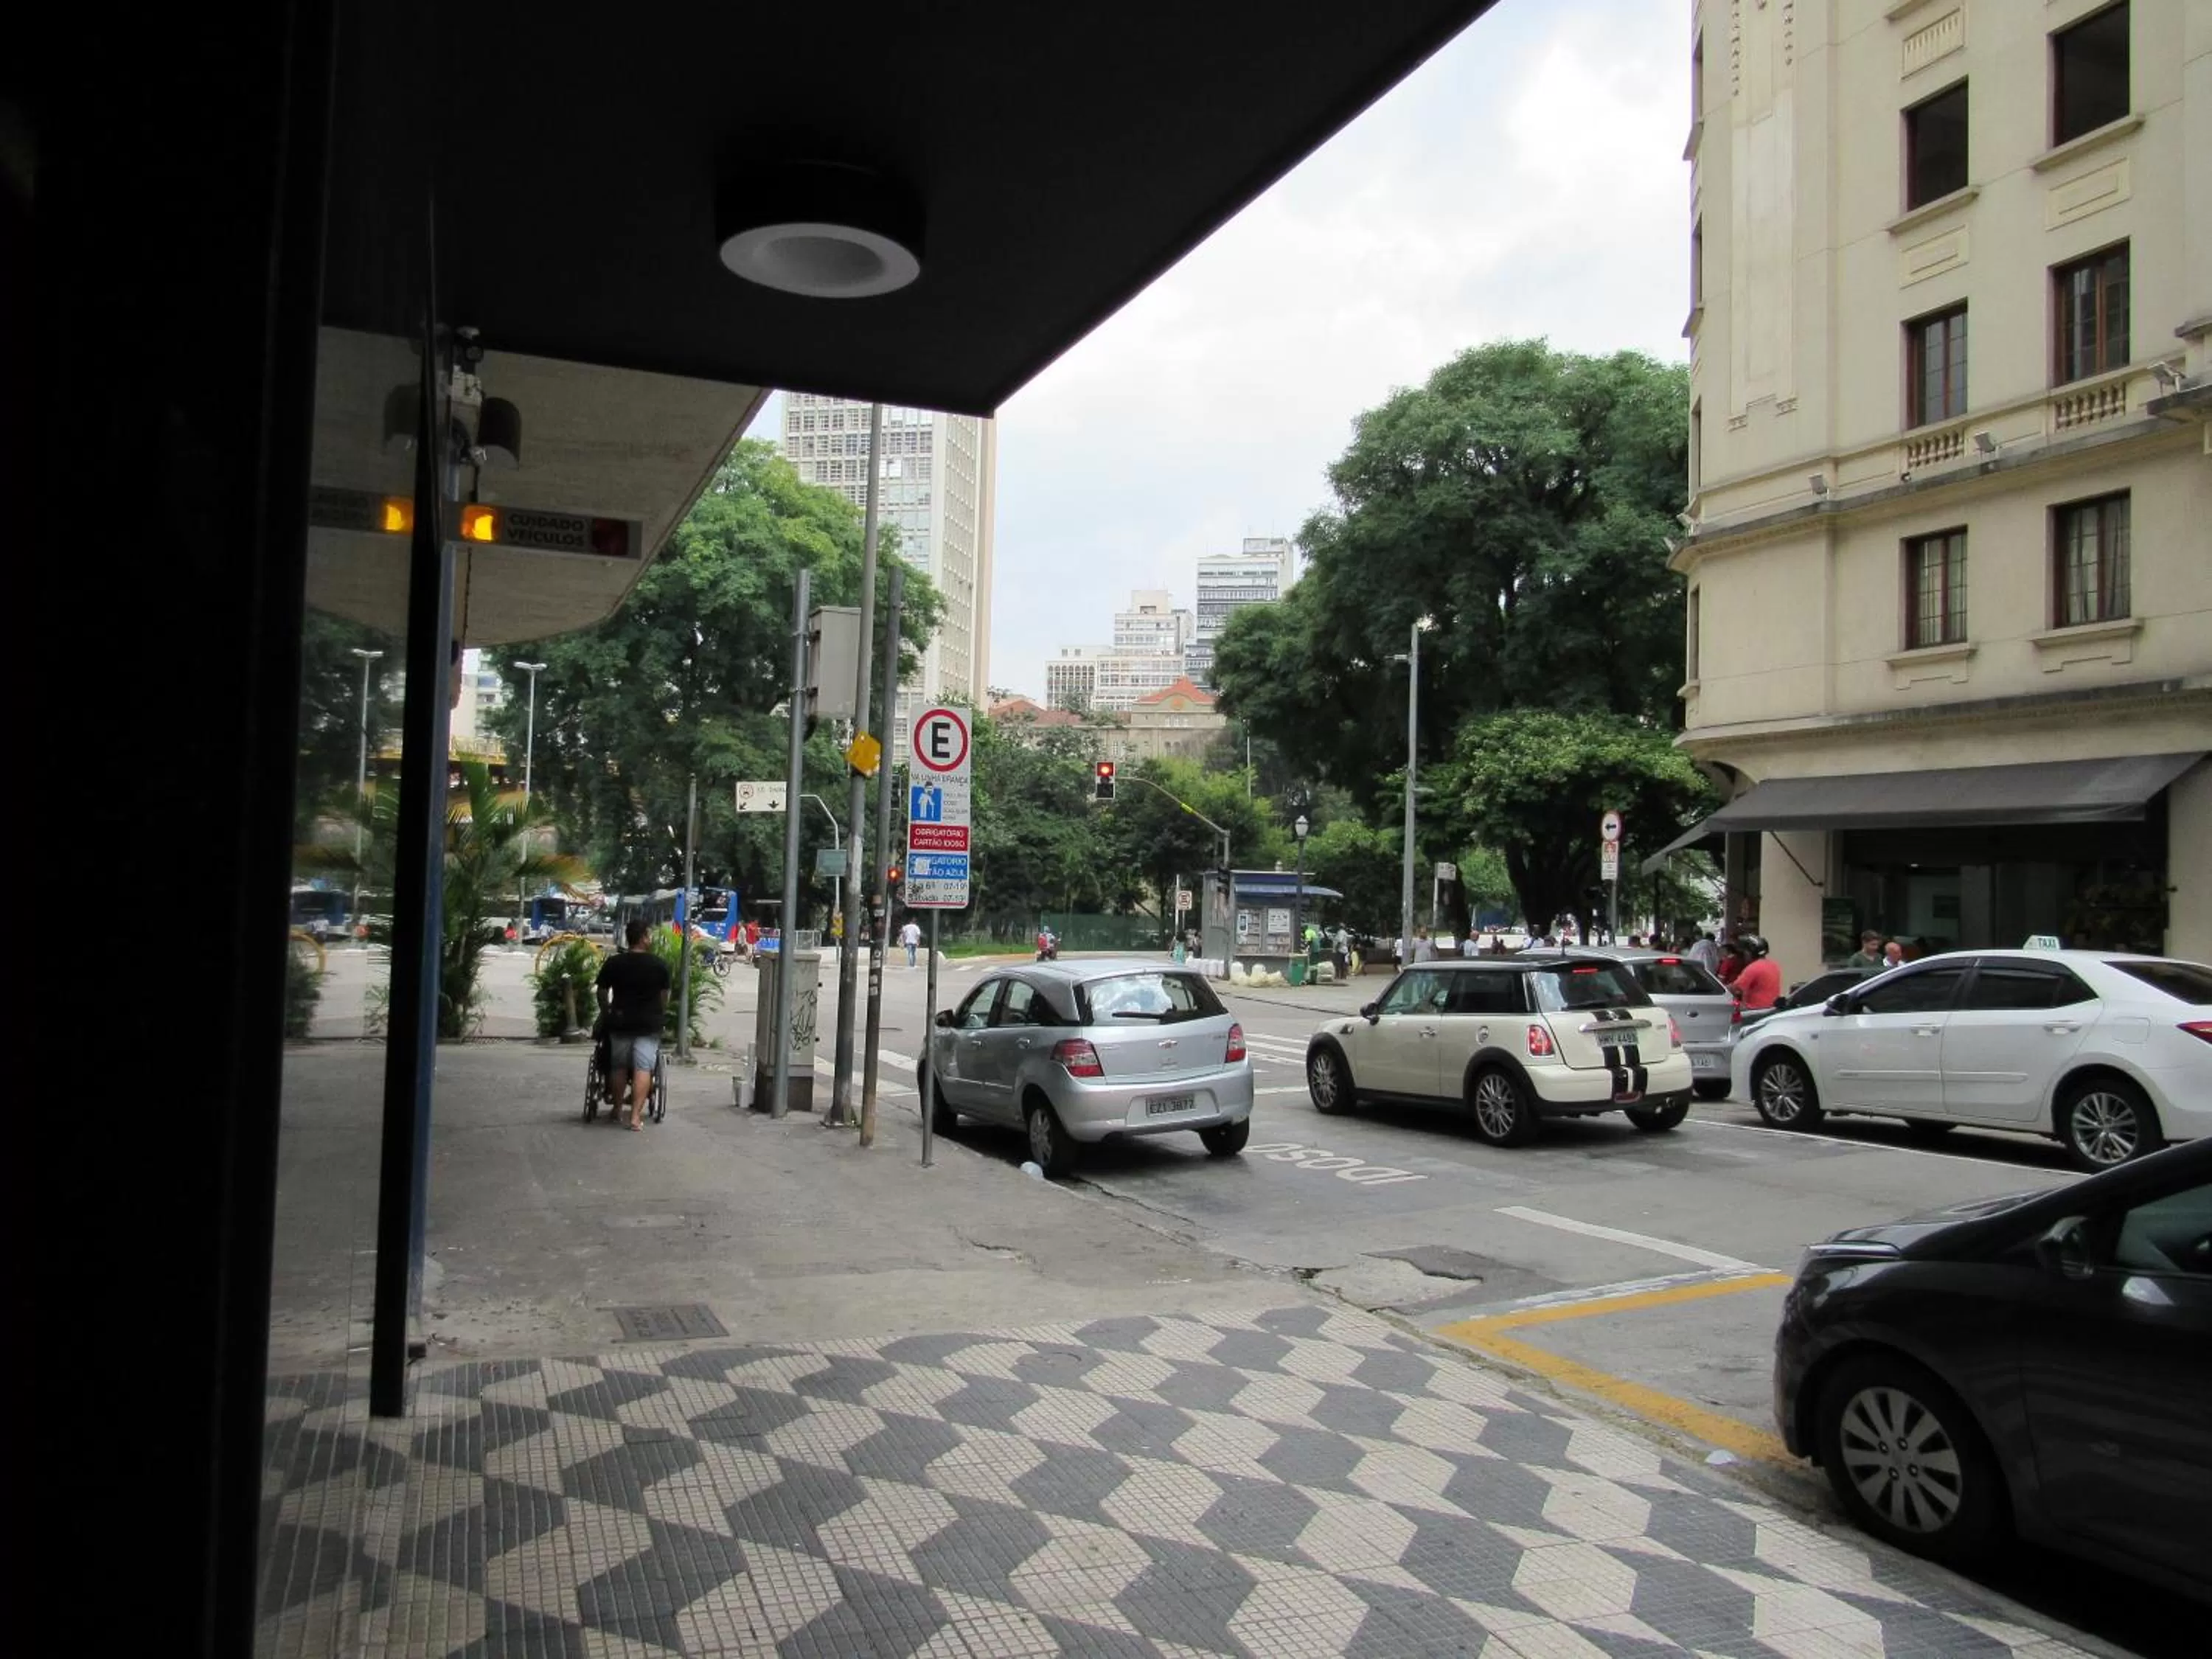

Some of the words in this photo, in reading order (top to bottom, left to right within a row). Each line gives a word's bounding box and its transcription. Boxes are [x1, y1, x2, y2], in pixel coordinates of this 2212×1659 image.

[509, 512, 584, 532] CUIDADO
[932, 722, 950, 758] E
[914, 838, 942, 846] CARTÃO
[944, 840, 965, 848] IDOSO
[910, 866, 944, 876] CTÃO
[2037, 937, 2056, 947] TAXI
